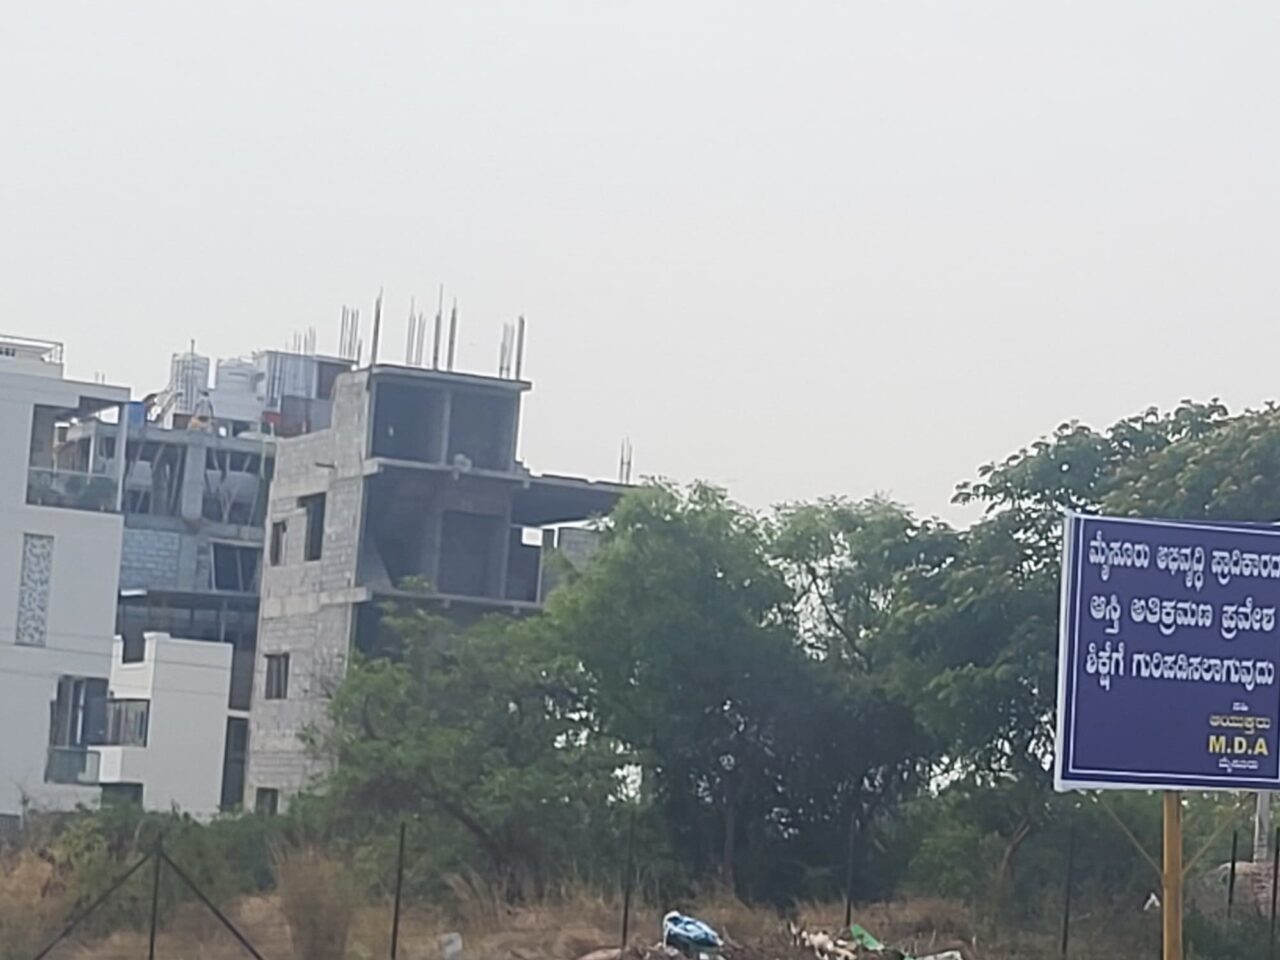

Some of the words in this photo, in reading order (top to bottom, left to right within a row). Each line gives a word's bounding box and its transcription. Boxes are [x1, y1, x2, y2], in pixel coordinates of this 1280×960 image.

[1089, 530, 1150, 581] ಮೈಸೂರು
[1090, 594, 1121, 634] ಆಸ್ತಿ
[1130, 597, 1213, 635] ಅತಿಕ್ರಮಣ
[1220, 597, 1276, 639] ಪ್ರವೇಶ
[1086, 641, 1125, 691] ಶಿಕ್ಷೆಗೆ
[1132, 652, 1275, 691] ಗುರಿಪಡಿಸಲಾಗುವುದು
[1209, 735, 1269, 756] M.D.A
